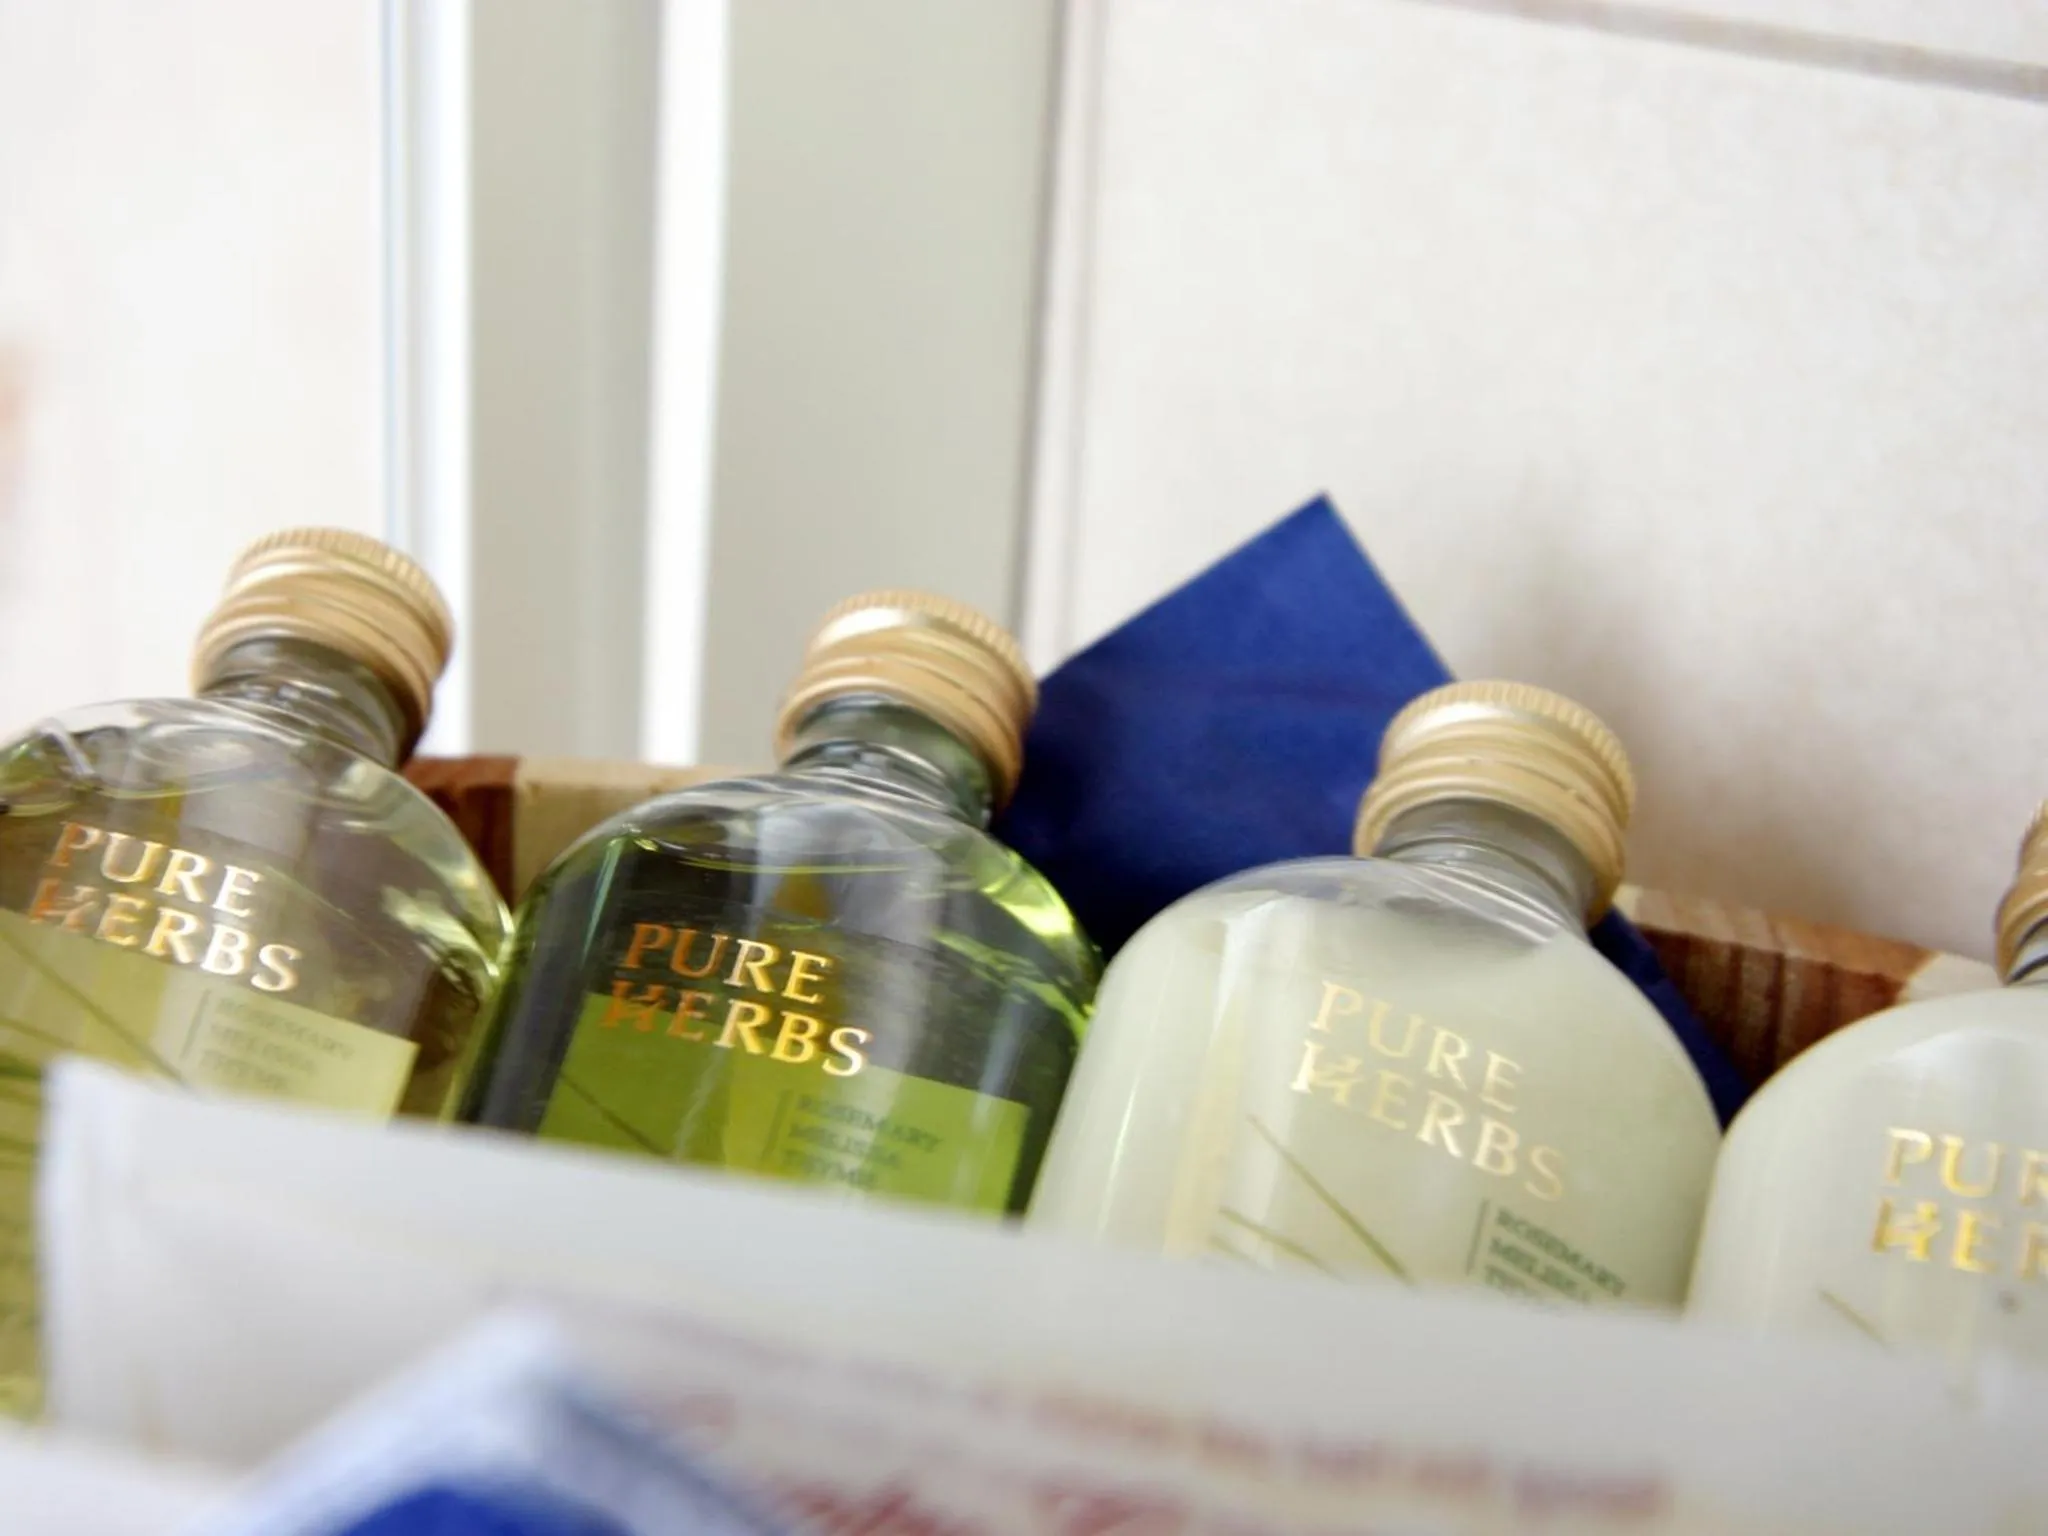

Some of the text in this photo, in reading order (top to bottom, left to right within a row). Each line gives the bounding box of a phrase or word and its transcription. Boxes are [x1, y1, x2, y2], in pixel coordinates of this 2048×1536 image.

[48, 821, 264, 918] PURE
[28, 878, 302, 992] HERBS
[622, 921, 833, 1004] PURE
[601, 979, 874, 1077] HERBS
[1309, 979, 1524, 1114] PURE
[1290, 1040, 1568, 1201] HERBS
